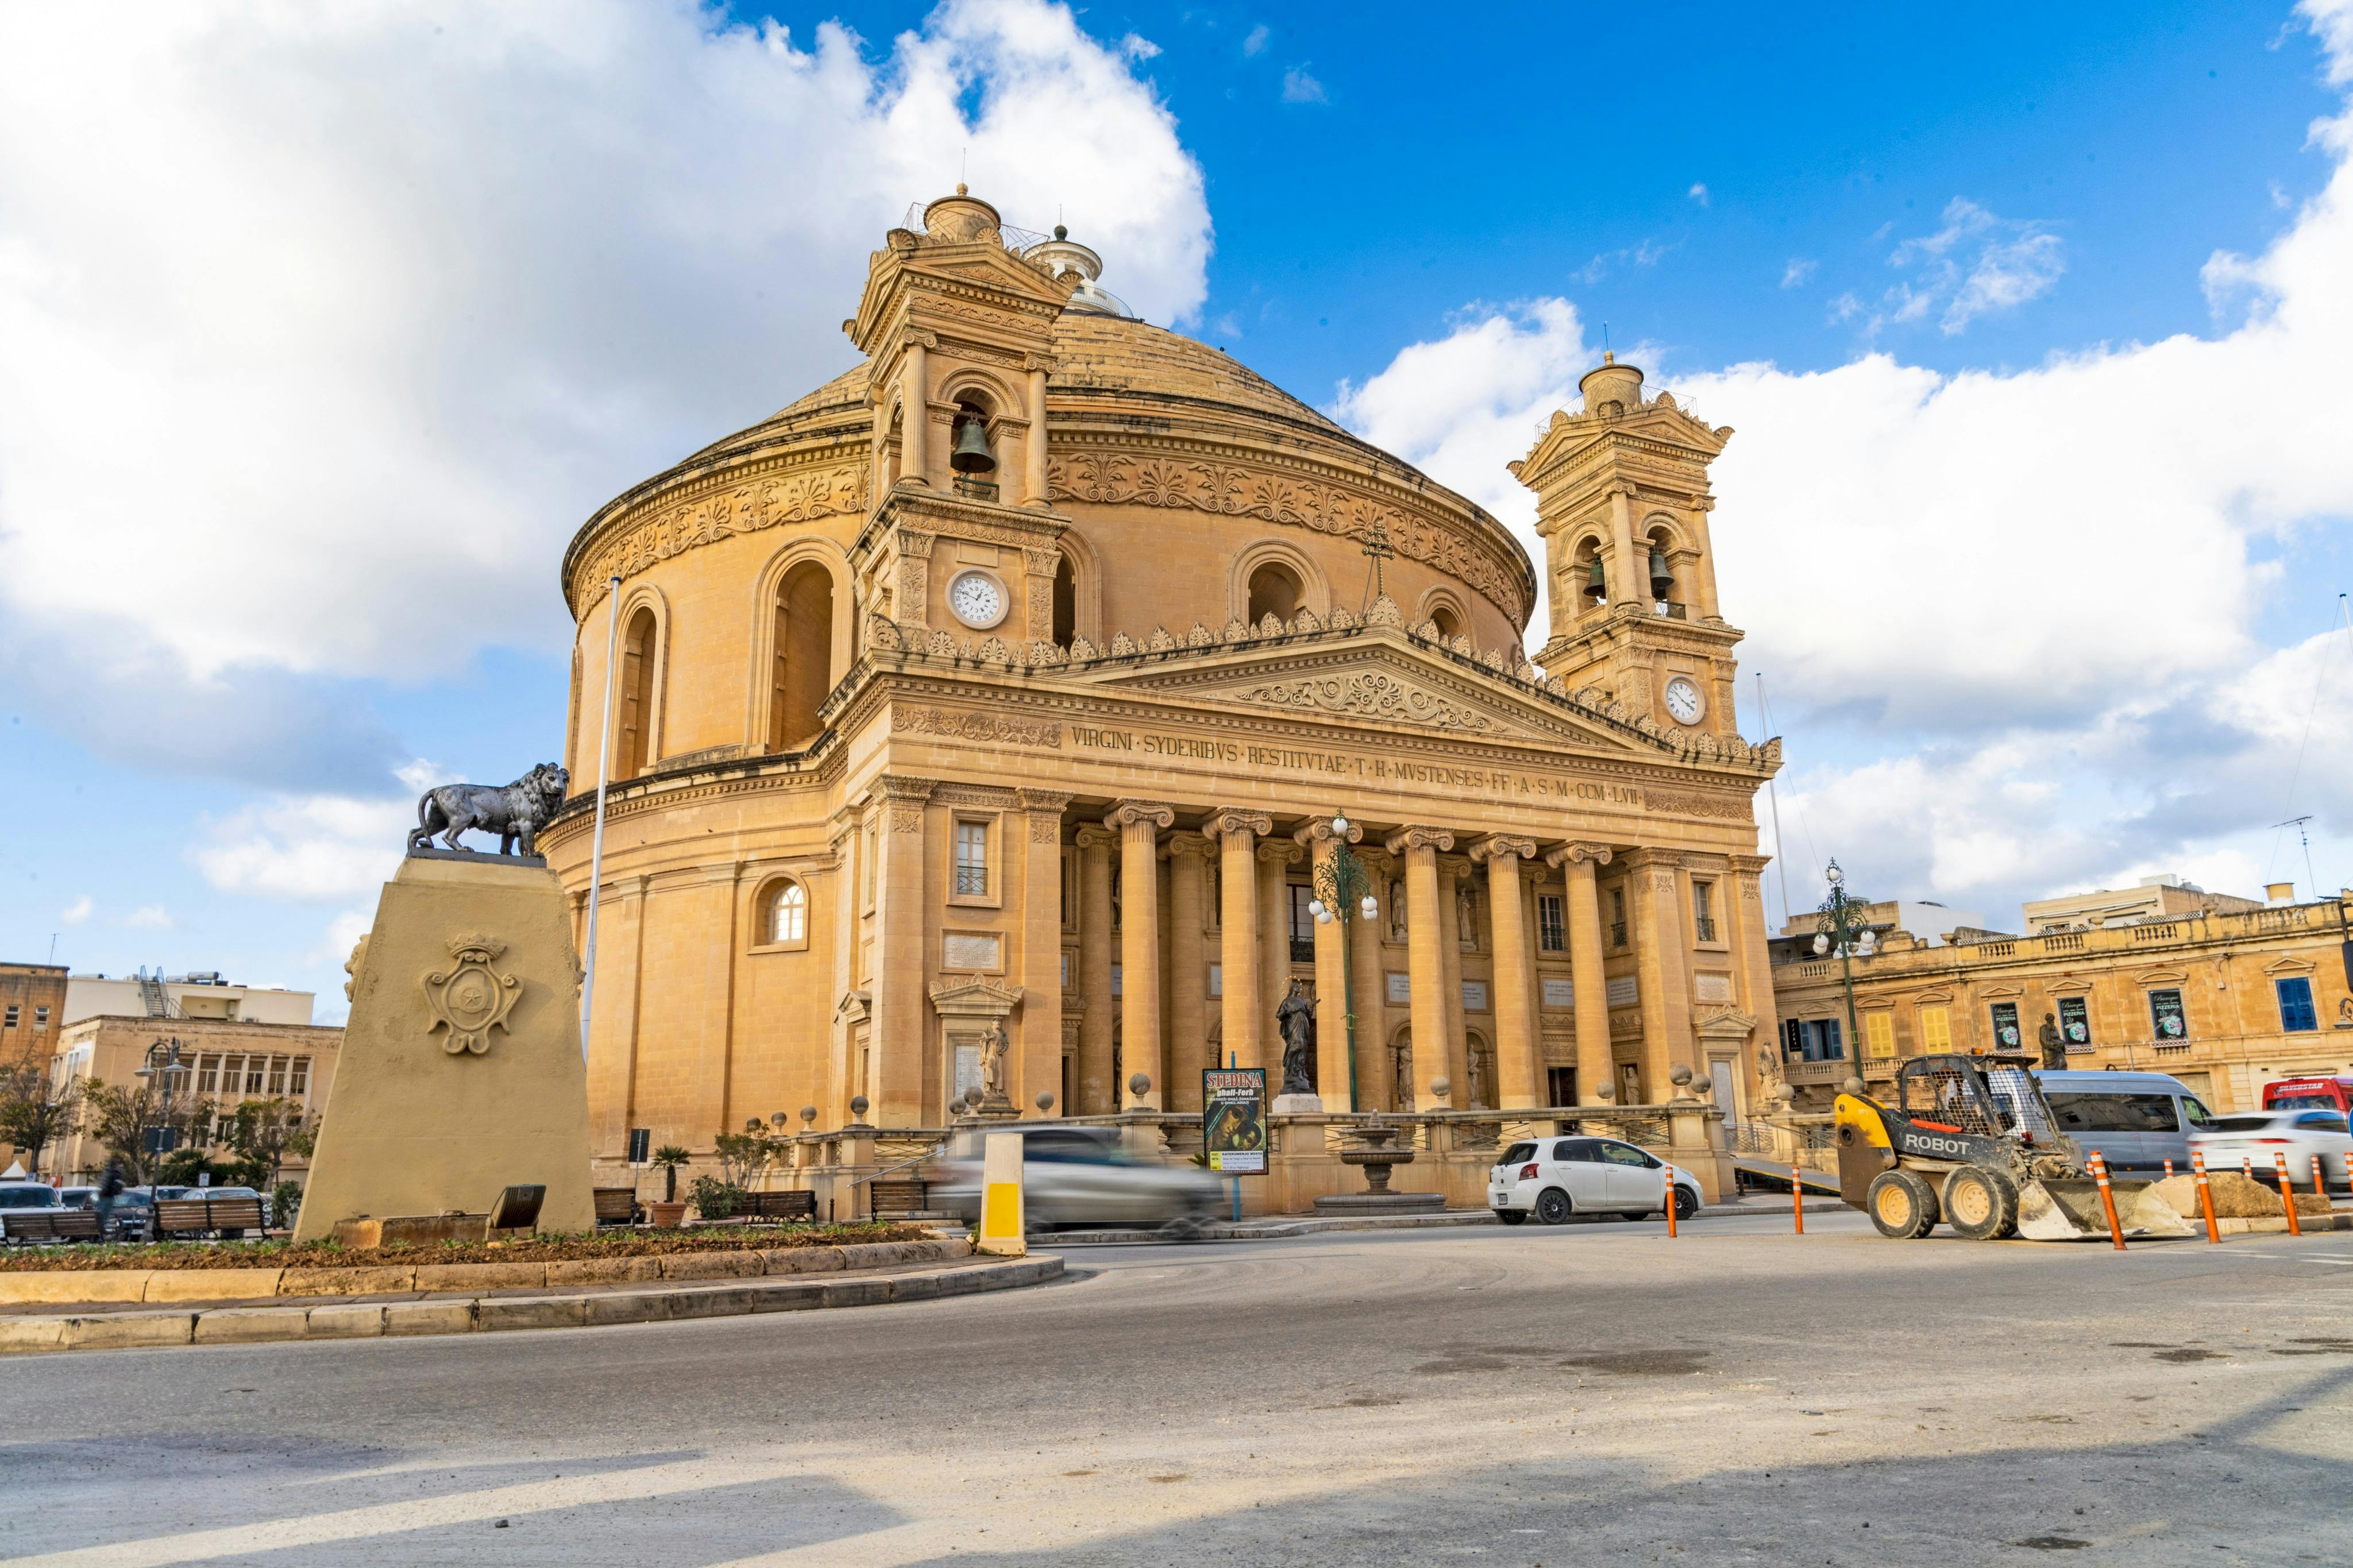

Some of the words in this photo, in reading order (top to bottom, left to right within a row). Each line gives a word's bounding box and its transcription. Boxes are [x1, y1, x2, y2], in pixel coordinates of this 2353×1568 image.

[1071, 727, 1132, 750] VIRGINI
[1144, 735, 1237, 762] SYDERIBVS
[1248, 747, 1346, 773] RESTITVTAE
[1355, 758, 1365, 774] T
[1375, 760, 1385, 777] H
[1395, 762, 1483, 787] MVSTENSES
[1520, 777, 1529, 792] A
[1538, 779, 1547, 794] S
[1556, 781, 1568, 796] M
[1577, 783, 1605, 800] CCM
[1613, 787, 1638, 804] LVII
[1207, 1072, 1263, 1088] STEDINA
[1905, 1134, 1970, 1154] ROBOT
